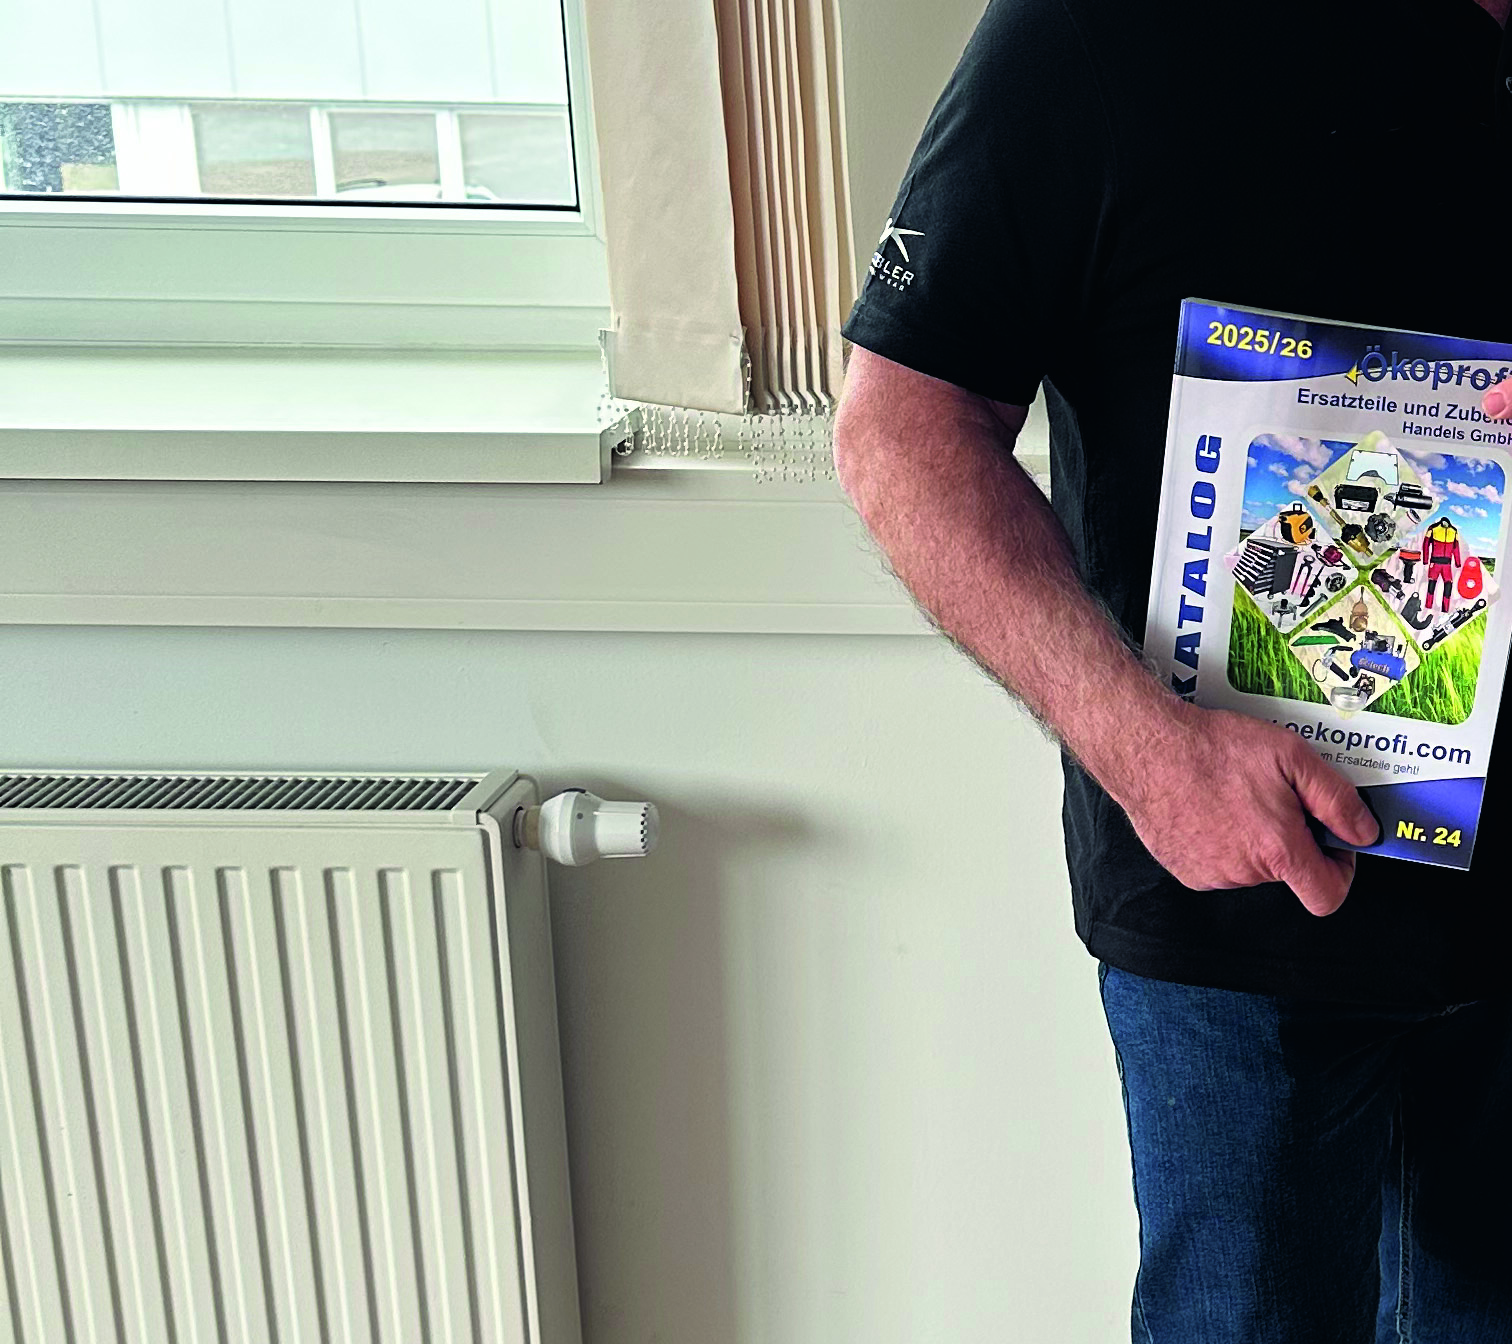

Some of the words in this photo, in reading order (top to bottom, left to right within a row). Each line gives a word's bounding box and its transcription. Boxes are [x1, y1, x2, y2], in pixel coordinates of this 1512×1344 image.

[871, 251, 915, 286] BLER
[1206, 321, 1313, 360] 2025/26
[1297, 387, 1398, 413] Ersatzteile
[1403, 402, 1441, 418] und
[1402, 421, 1466, 441] Handels
[1171, 434, 1222, 703] KATALOG
[1284, 720, 1472, 765] oekoprofi.com
[1396, 820, 1427, 842] Nr.
[1432, 826, 1462, 848] 24
